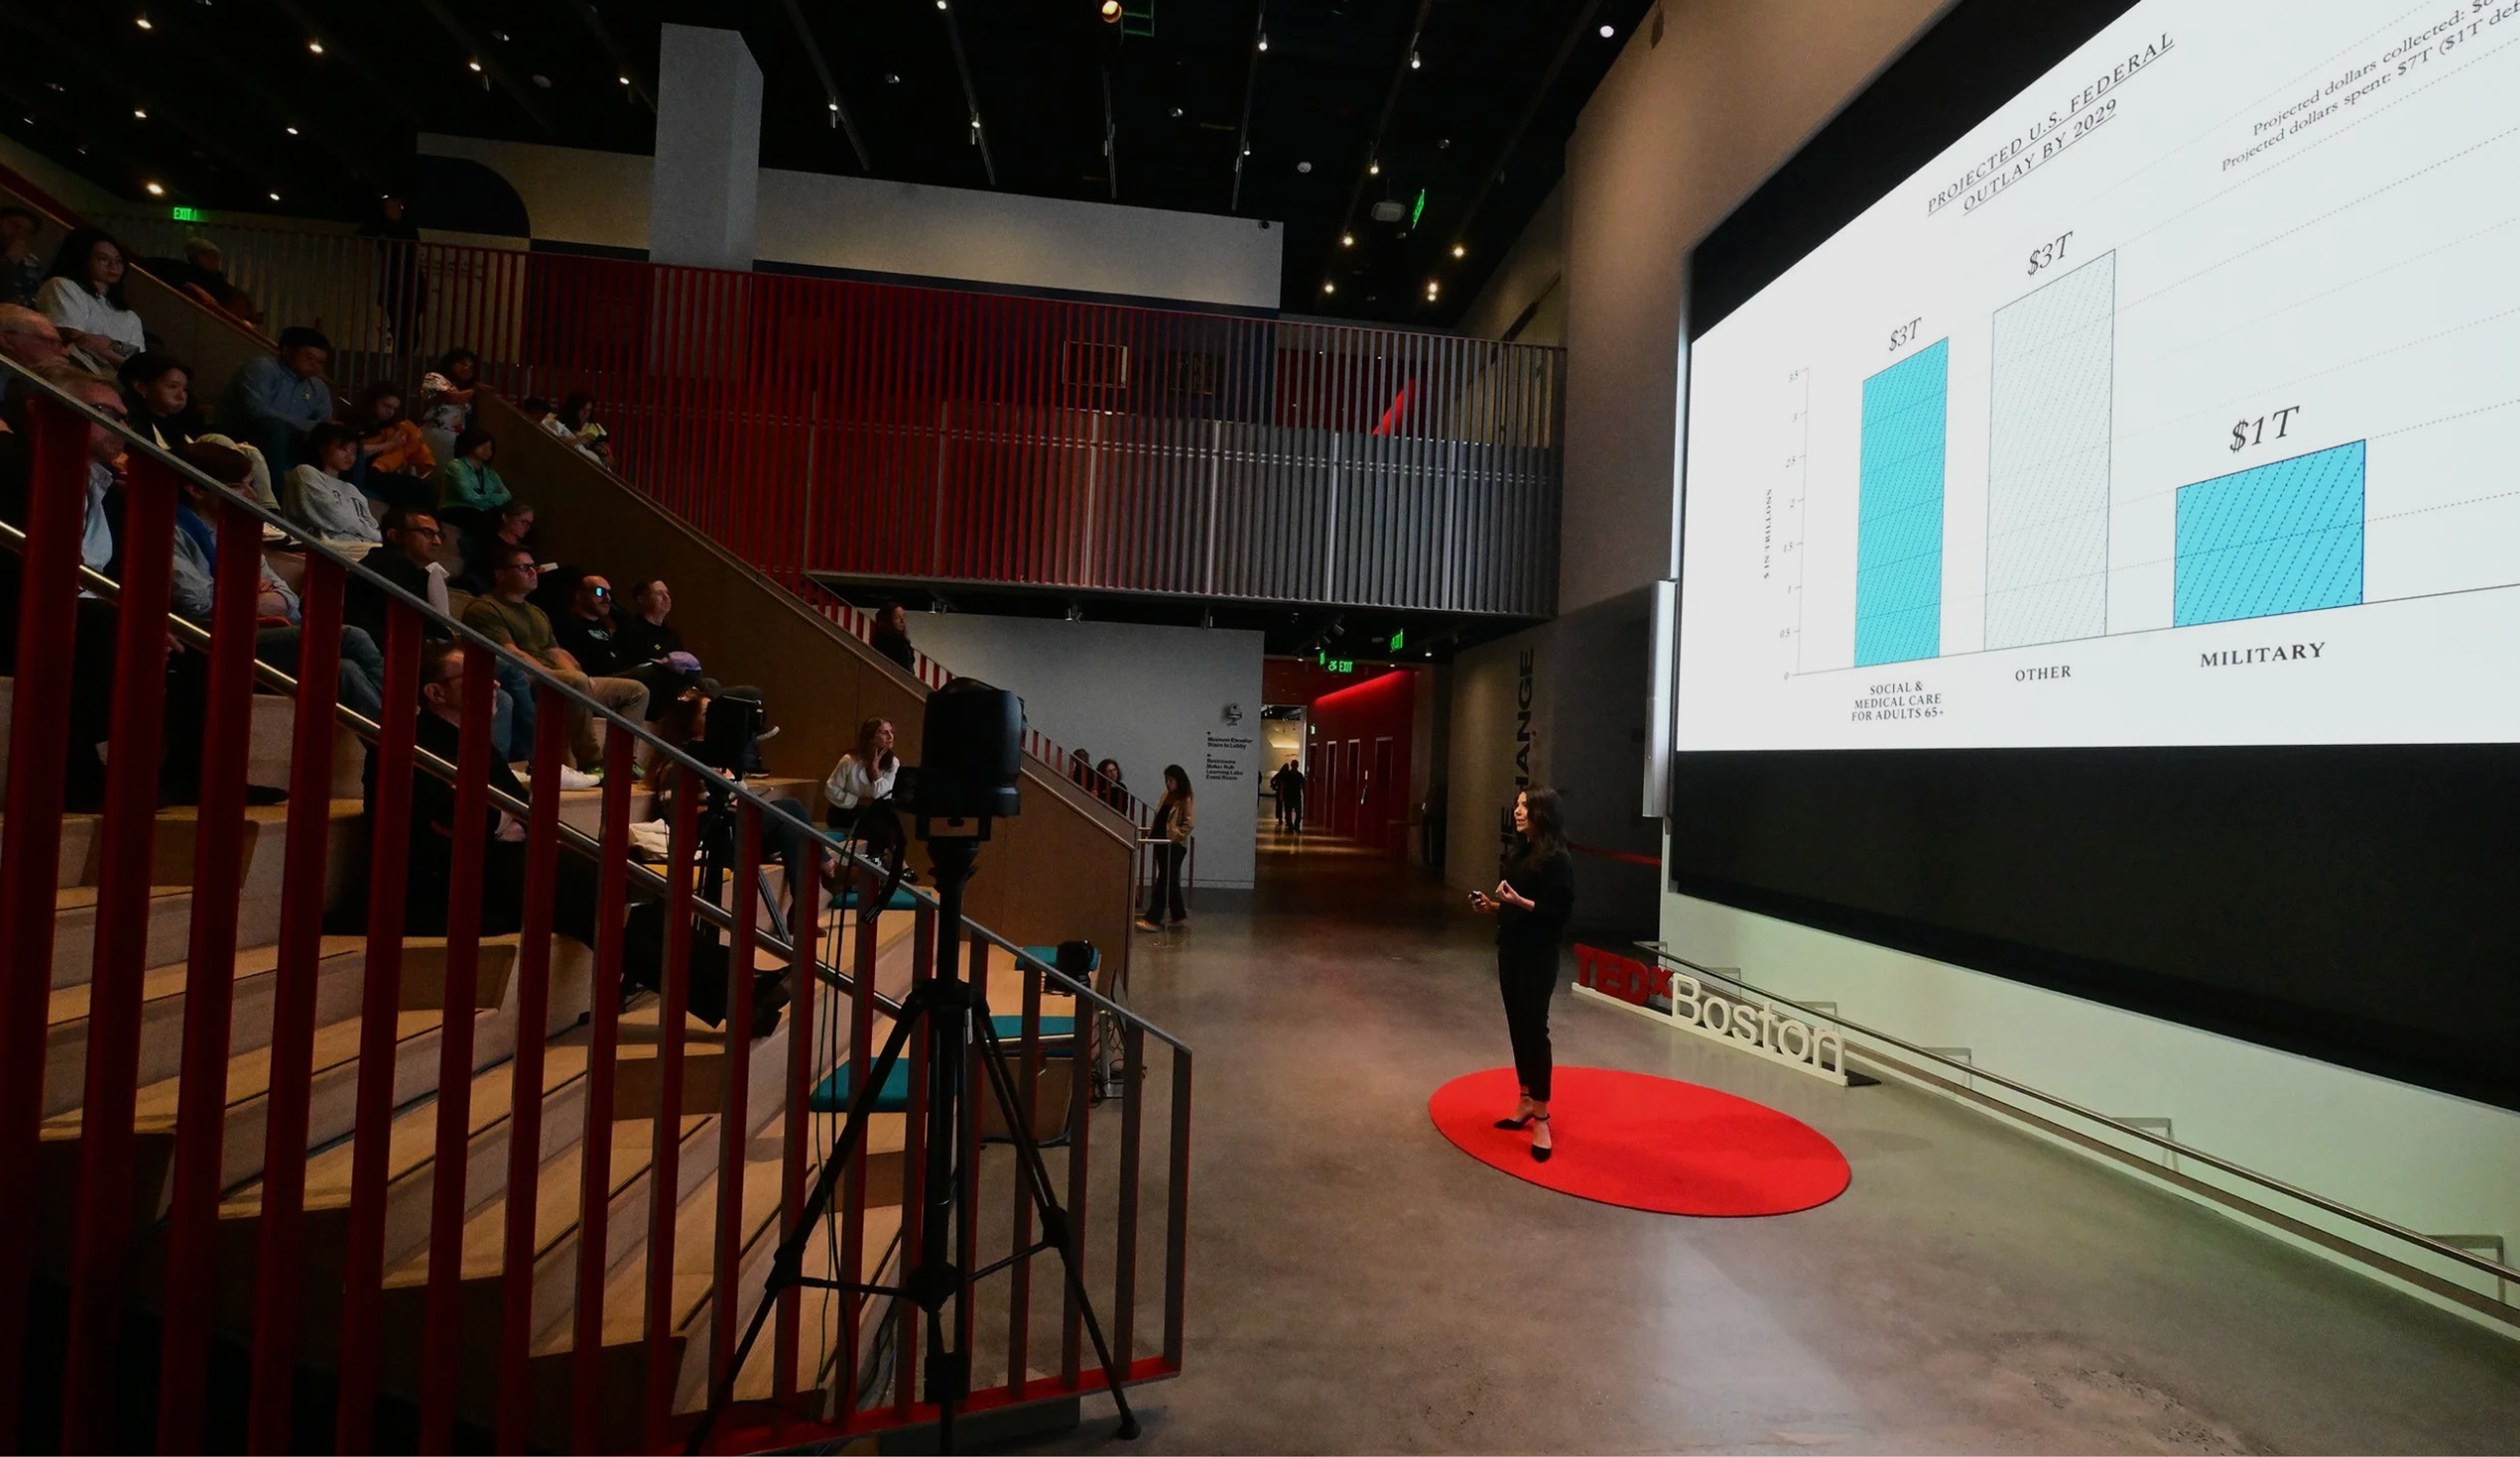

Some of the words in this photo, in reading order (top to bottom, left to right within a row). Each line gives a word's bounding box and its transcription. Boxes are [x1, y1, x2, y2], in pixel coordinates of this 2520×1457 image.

[2254, 90, 2320, 136] Projected
[2325, 61, 2376, 95] dollars
[2383, 10, 2465, 63] collected:
[2222, 128, 2285, 172] Projected
[2290, 103, 2338, 135] dollars
[2344, 73, 2391, 105] spent:
[2398, 46, 2433, 76] $7T
[2439, 19, 2483, 55] ($1T
[1927, 138, 2022, 213] PROJECTED
[2030, 111, 2063, 140] U.S.
[2070, 32, 2174, 113] FEDERAL
[1963, 153, 2035, 211] OUTLAY
[2043, 131, 2066, 159] BY
[2074, 98, 2117, 138] 2029
[173, 207, 192, 221] EXIT
[2028, 230, 2073, 277] $3T
[1889, 317, 1922, 352] $3T
[2230, 405, 2300, 454] $1T
[1339, 660, 1353, 673] EXIT
[2200, 641, 2326, 668] MILITARY
[1870, 681, 1912, 695] SOCIAL
[1915, 681, 1924, 691] &
[2015, 665, 2071, 681] OTHER
[1851, 710, 1872, 721] FOR
[1875, 708, 1922, 720] ADULTS
[1924, 706, 1944, 718] 65+
[1854, 696, 1905, 709] MEDICAL
[1908, 693, 1942, 706] CARE
